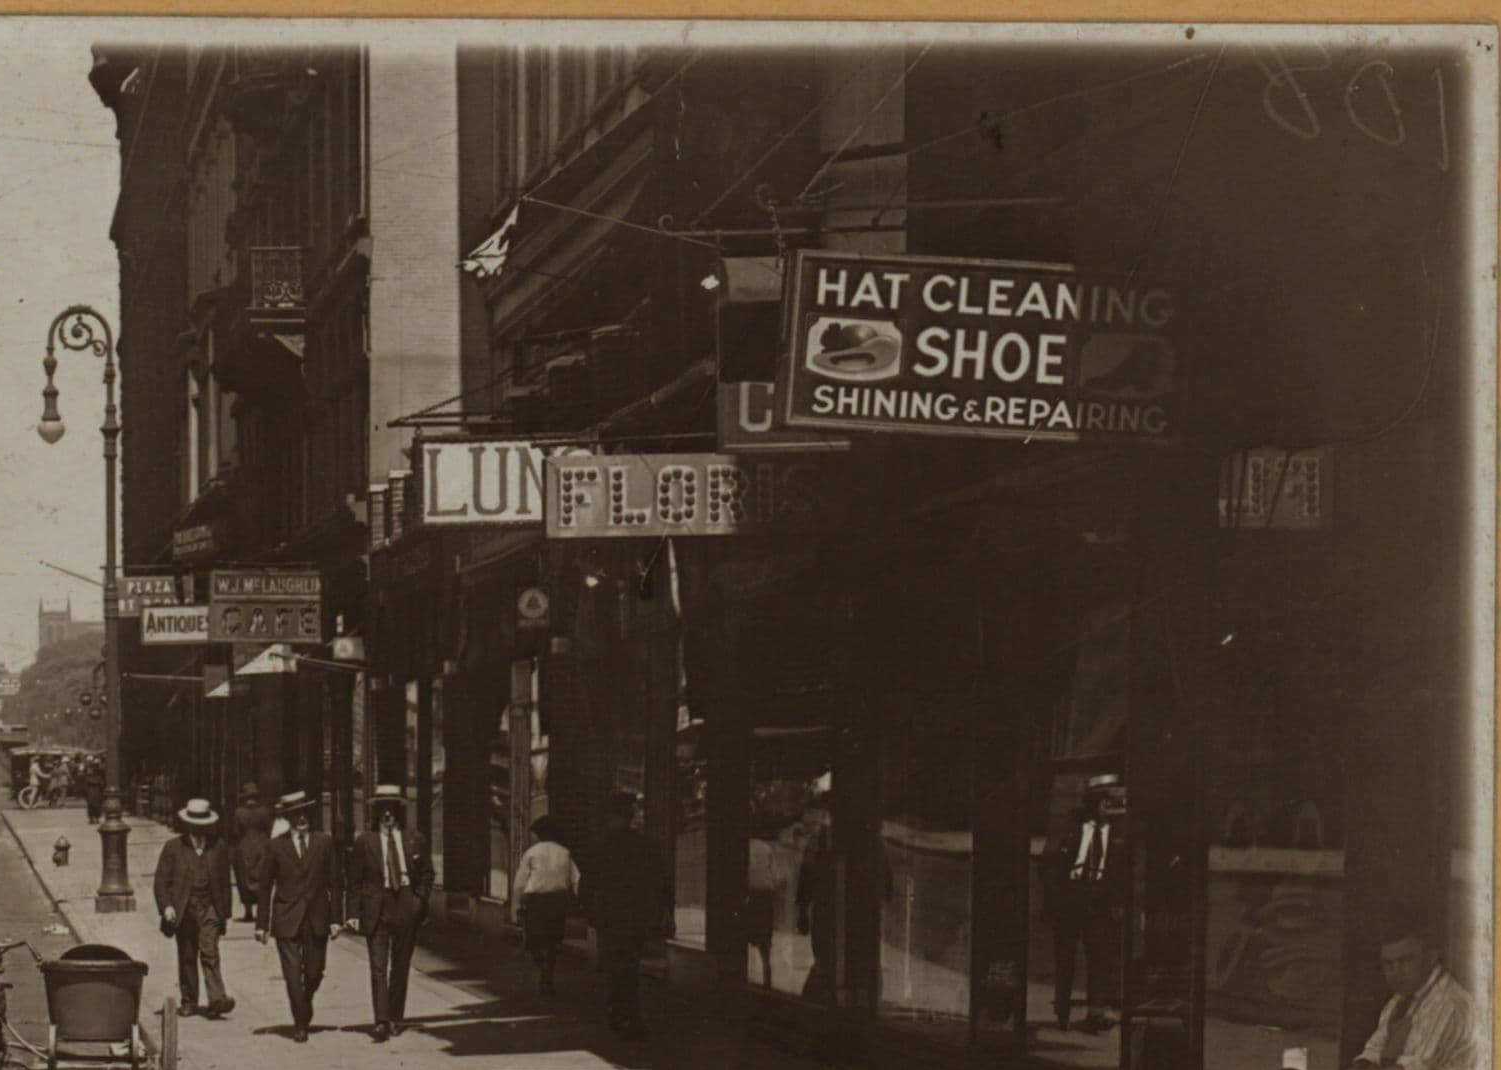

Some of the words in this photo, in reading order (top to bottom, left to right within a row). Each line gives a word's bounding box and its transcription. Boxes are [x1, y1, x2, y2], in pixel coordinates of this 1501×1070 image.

[815, 267, 911, 310] HAT
[921, 273, 1175, 327] CLEANING
[911, 326, 1068, 386] SHOE
[426, 445, 556, 518] LUN
